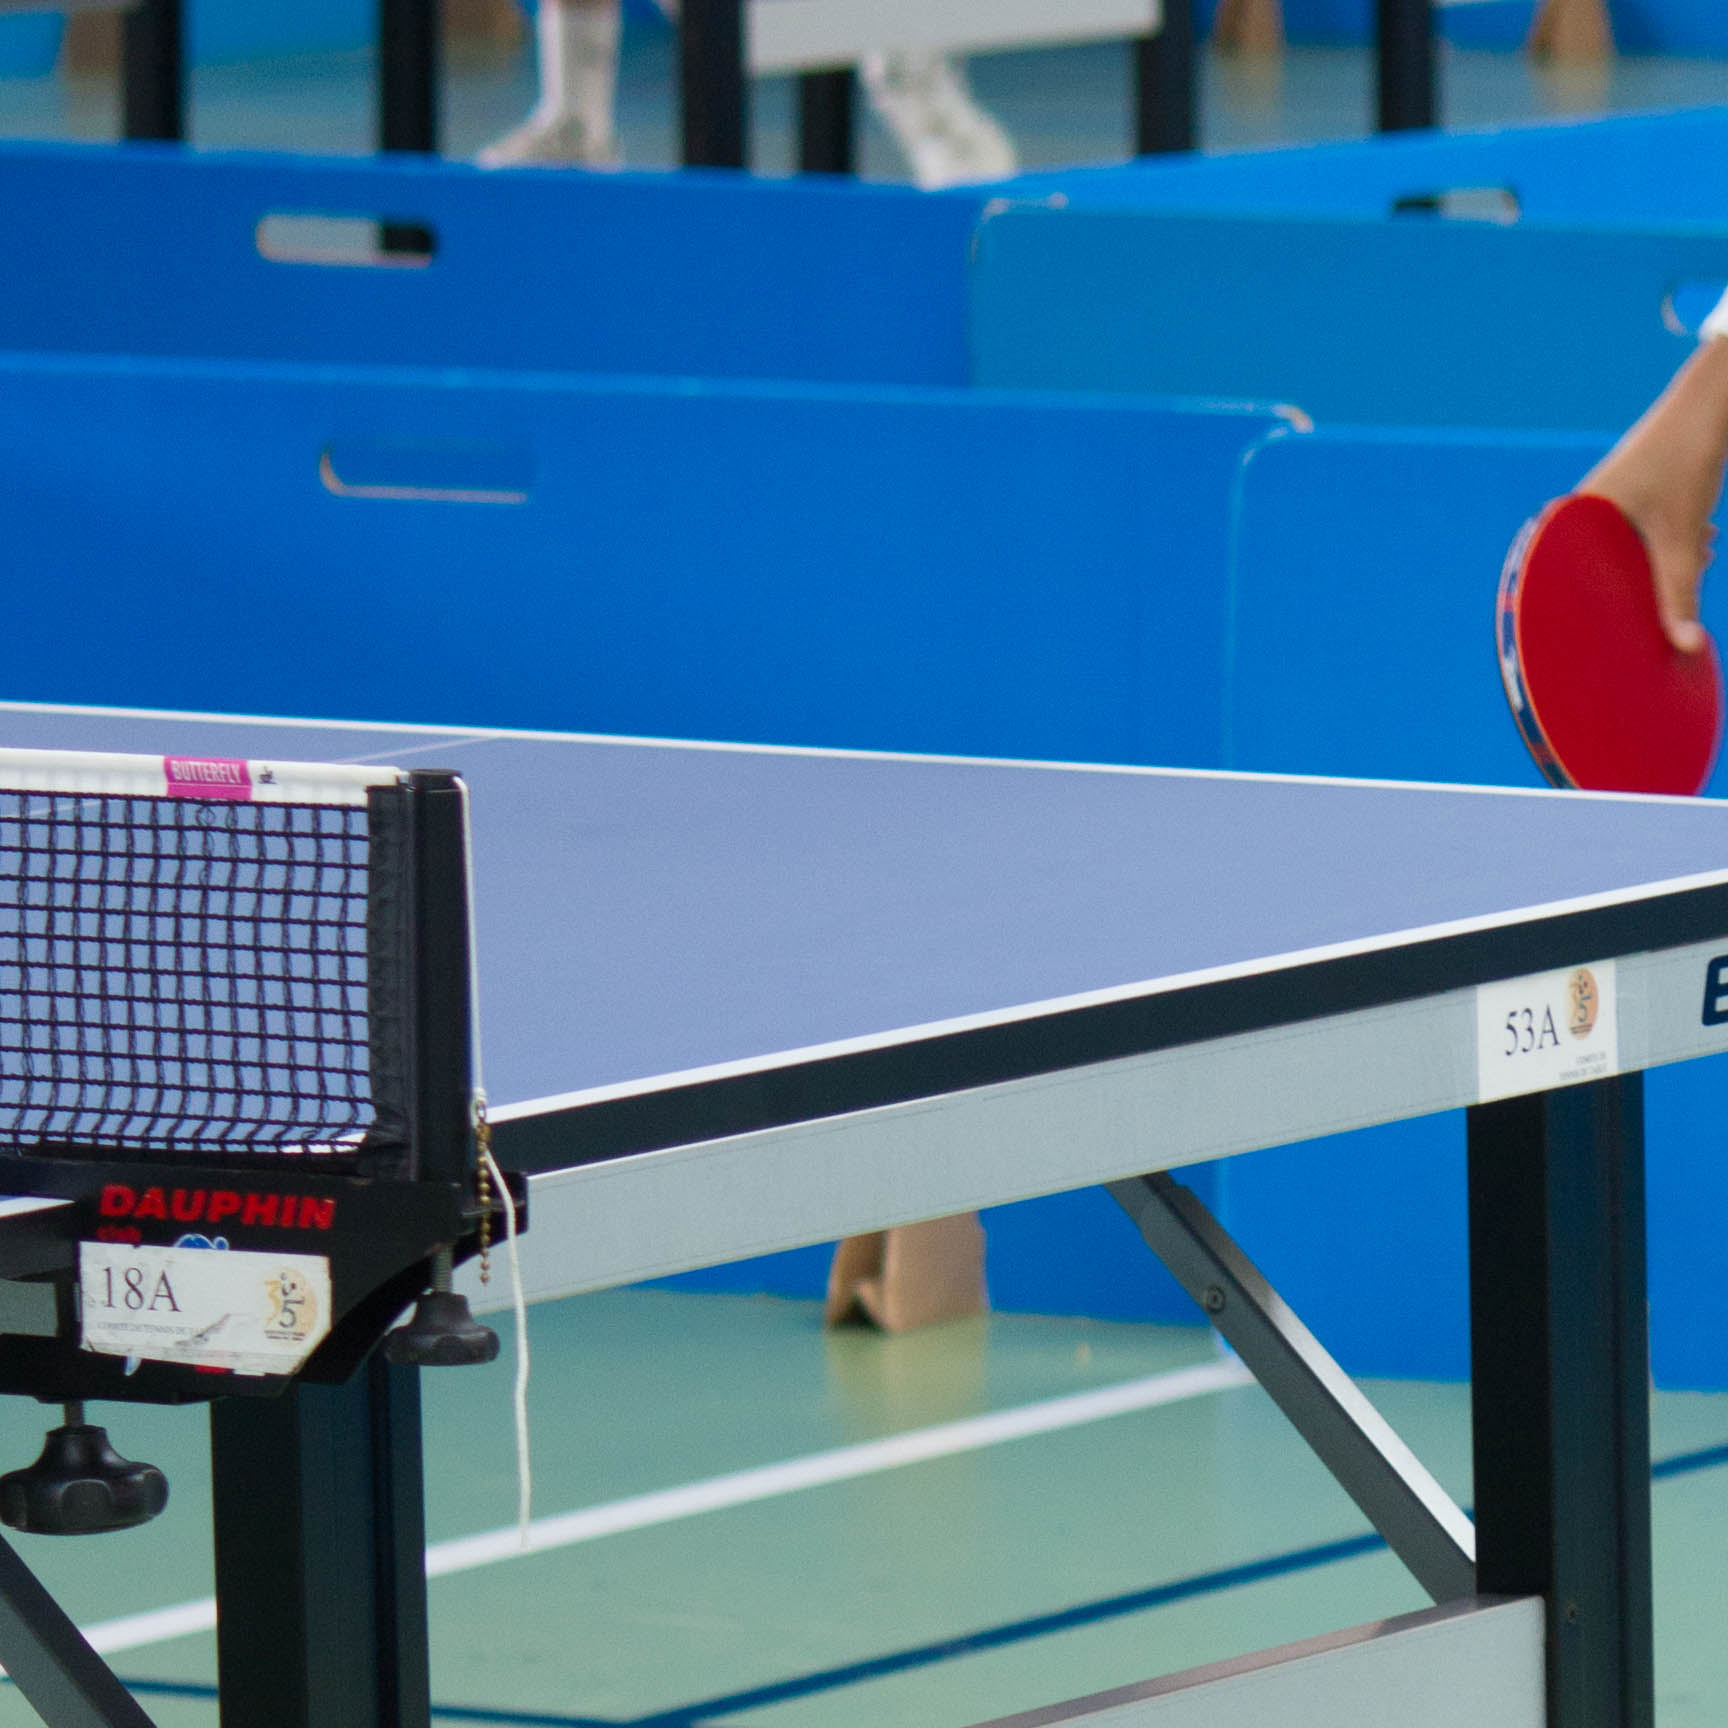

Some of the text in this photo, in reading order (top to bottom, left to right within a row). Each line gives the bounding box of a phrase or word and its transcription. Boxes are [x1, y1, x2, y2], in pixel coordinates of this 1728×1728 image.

[170, 759, 241, 783] BUTTERFLY
[1504, 1002, 1560, 1056] 53A
[100, 1184, 337, 1230] DAUPHIN
[101, 1266, 182, 1312] 18A
